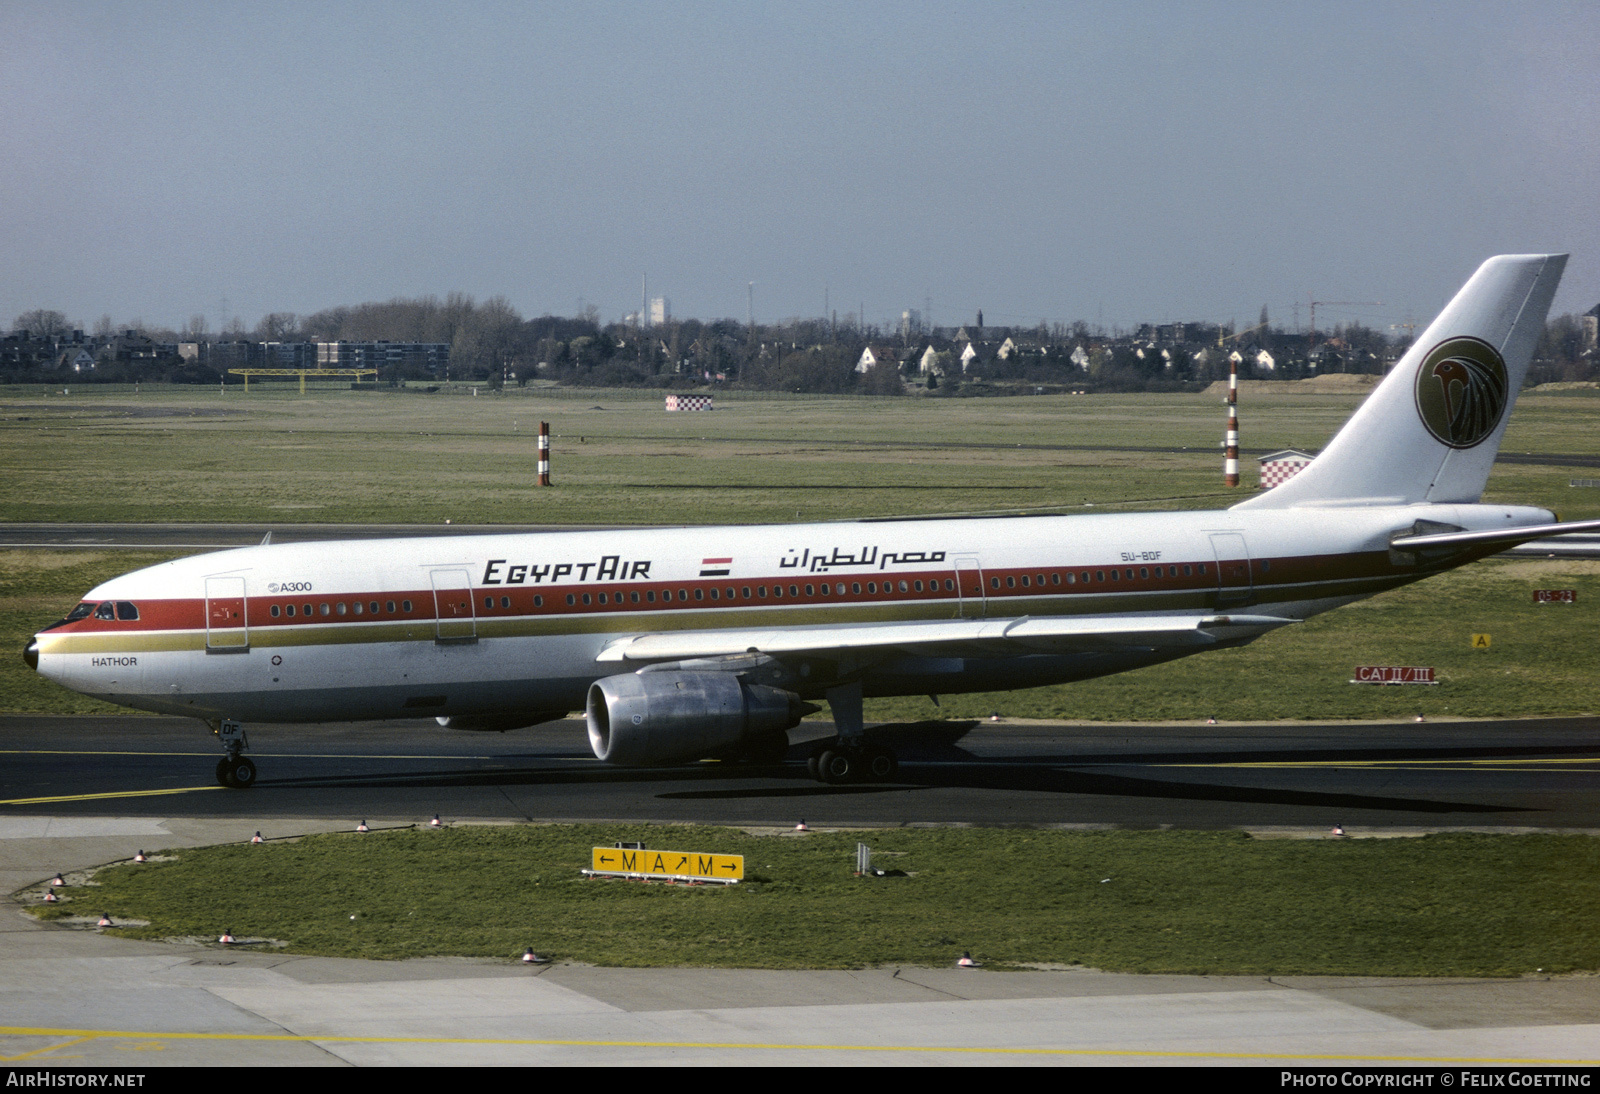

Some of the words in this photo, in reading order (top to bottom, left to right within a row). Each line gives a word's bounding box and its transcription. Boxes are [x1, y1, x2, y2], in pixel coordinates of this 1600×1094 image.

[779, 546, 878, 572] للطيران
[880, 551, 946, 570] مصر
[280, 582, 312, 592] A300
[1476, 635, 1487, 647] A
[92, 657, 137, 667] HATHOR
[1360, 667, 1388, 681] CAT
[622, 851, 636, 871] M
[653, 853, 665, 873] A
[699, 856, 713, 876] M
